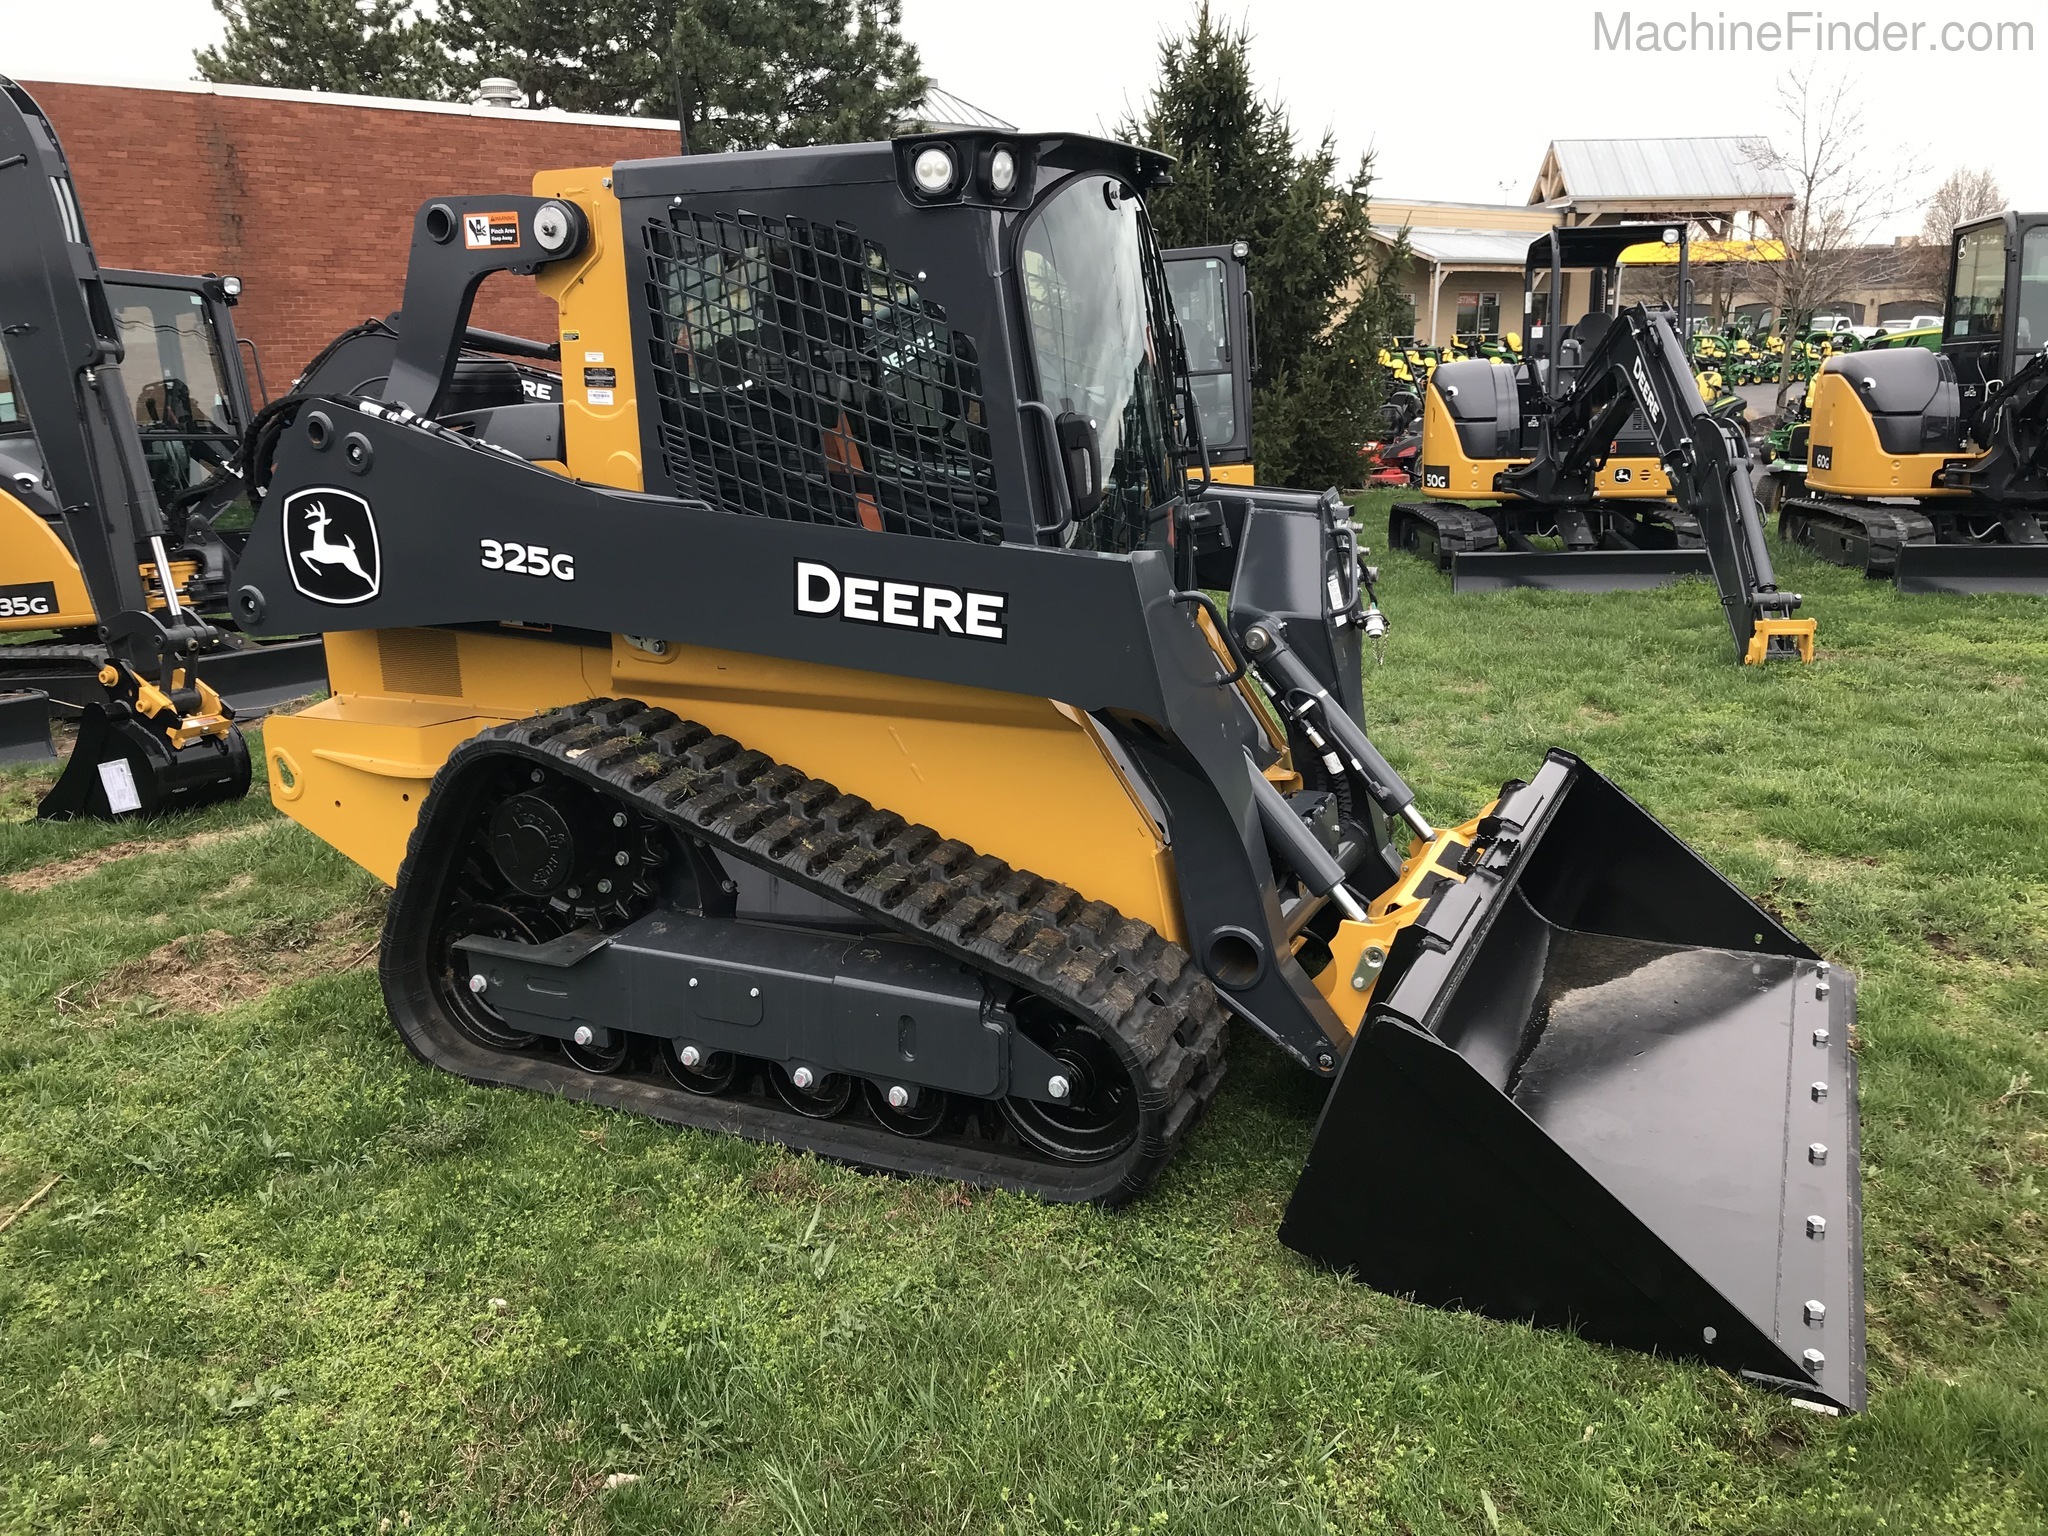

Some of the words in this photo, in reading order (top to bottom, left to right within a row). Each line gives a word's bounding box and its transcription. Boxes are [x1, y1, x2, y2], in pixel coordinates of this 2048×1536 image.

[1633, 355, 1660, 423] DEERE
[1816, 454, 1830, 469] 60G
[1426, 473, 1446, 488] 50G
[480, 539, 575, 581] 325G
[0, 596, 49, 617] 35G
[797, 561, 1004, 639] DEERE
